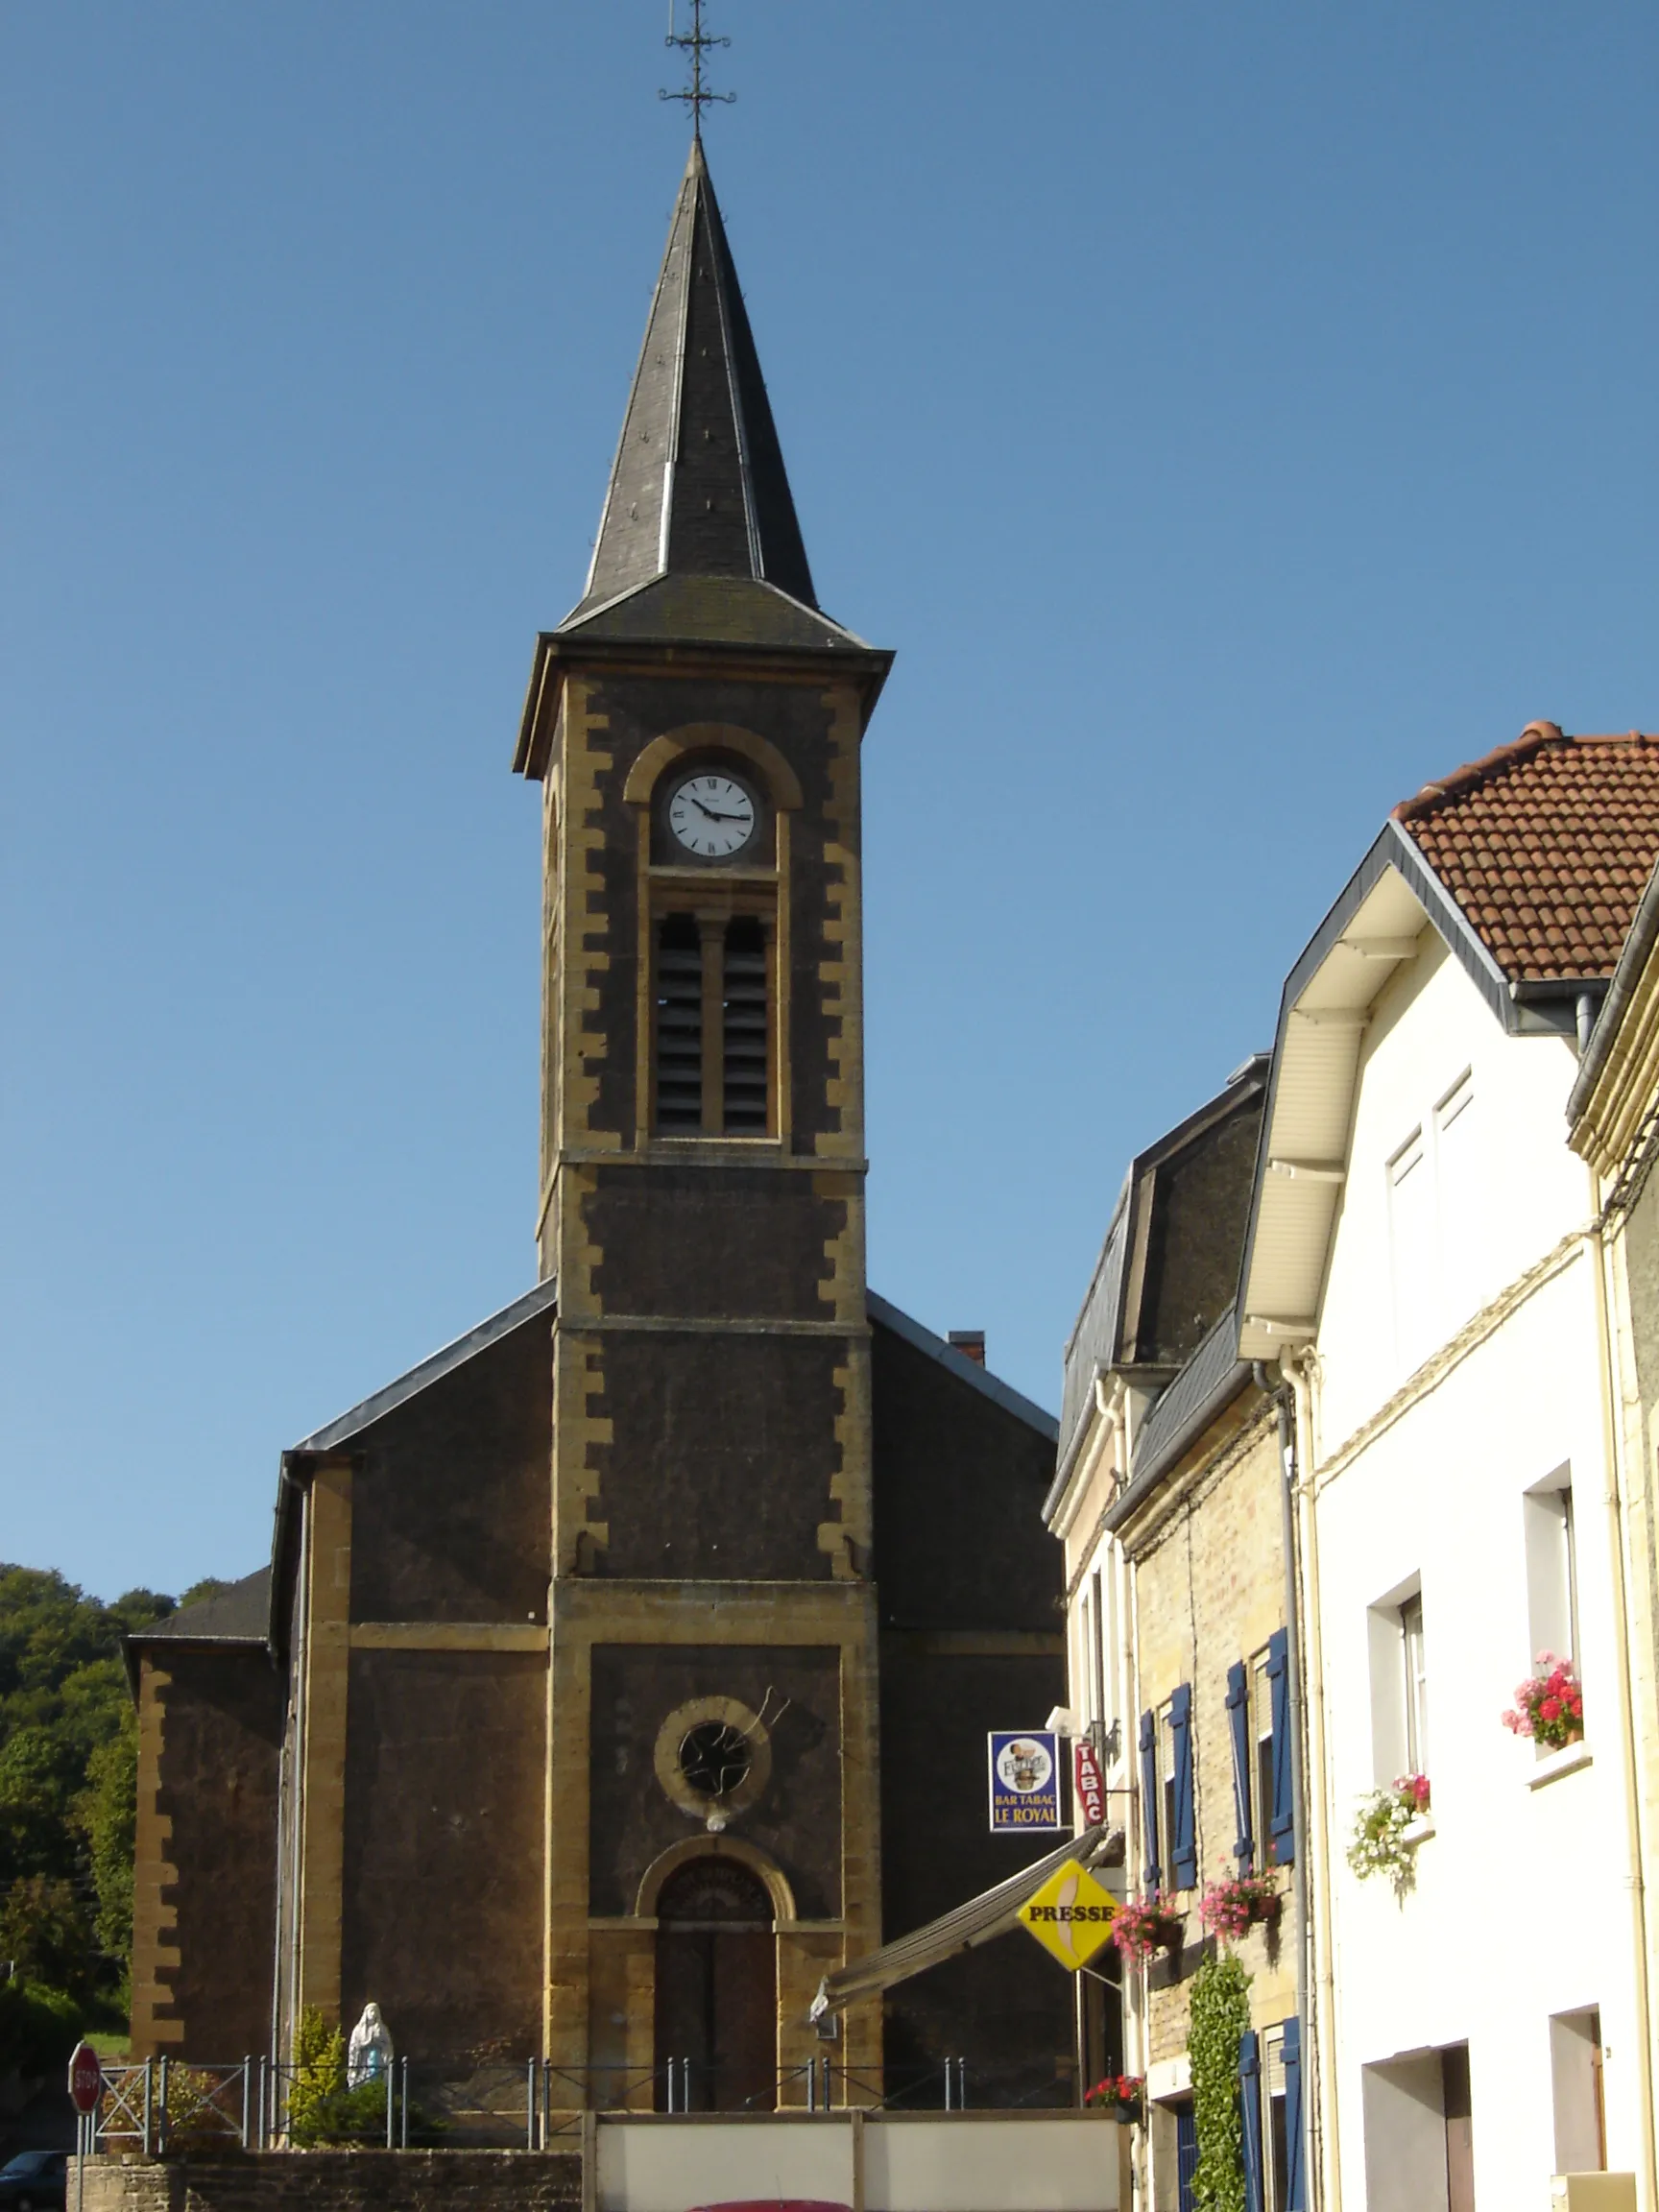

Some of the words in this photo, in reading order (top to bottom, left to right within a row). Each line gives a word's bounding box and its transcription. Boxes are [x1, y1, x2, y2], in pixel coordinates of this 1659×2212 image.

[1078, 1746, 1101, 1821] TABAC
[995, 1795, 1018, 1806] BAR
[1020, 1794, 1056, 1806] TABAC
[995, 1808, 1010, 1823] LE
[1013, 1807, 1057, 1823] ROYAL
[1028, 1906, 1115, 1921] PRESSE
[76, 2070, 98, 2089] STOP
